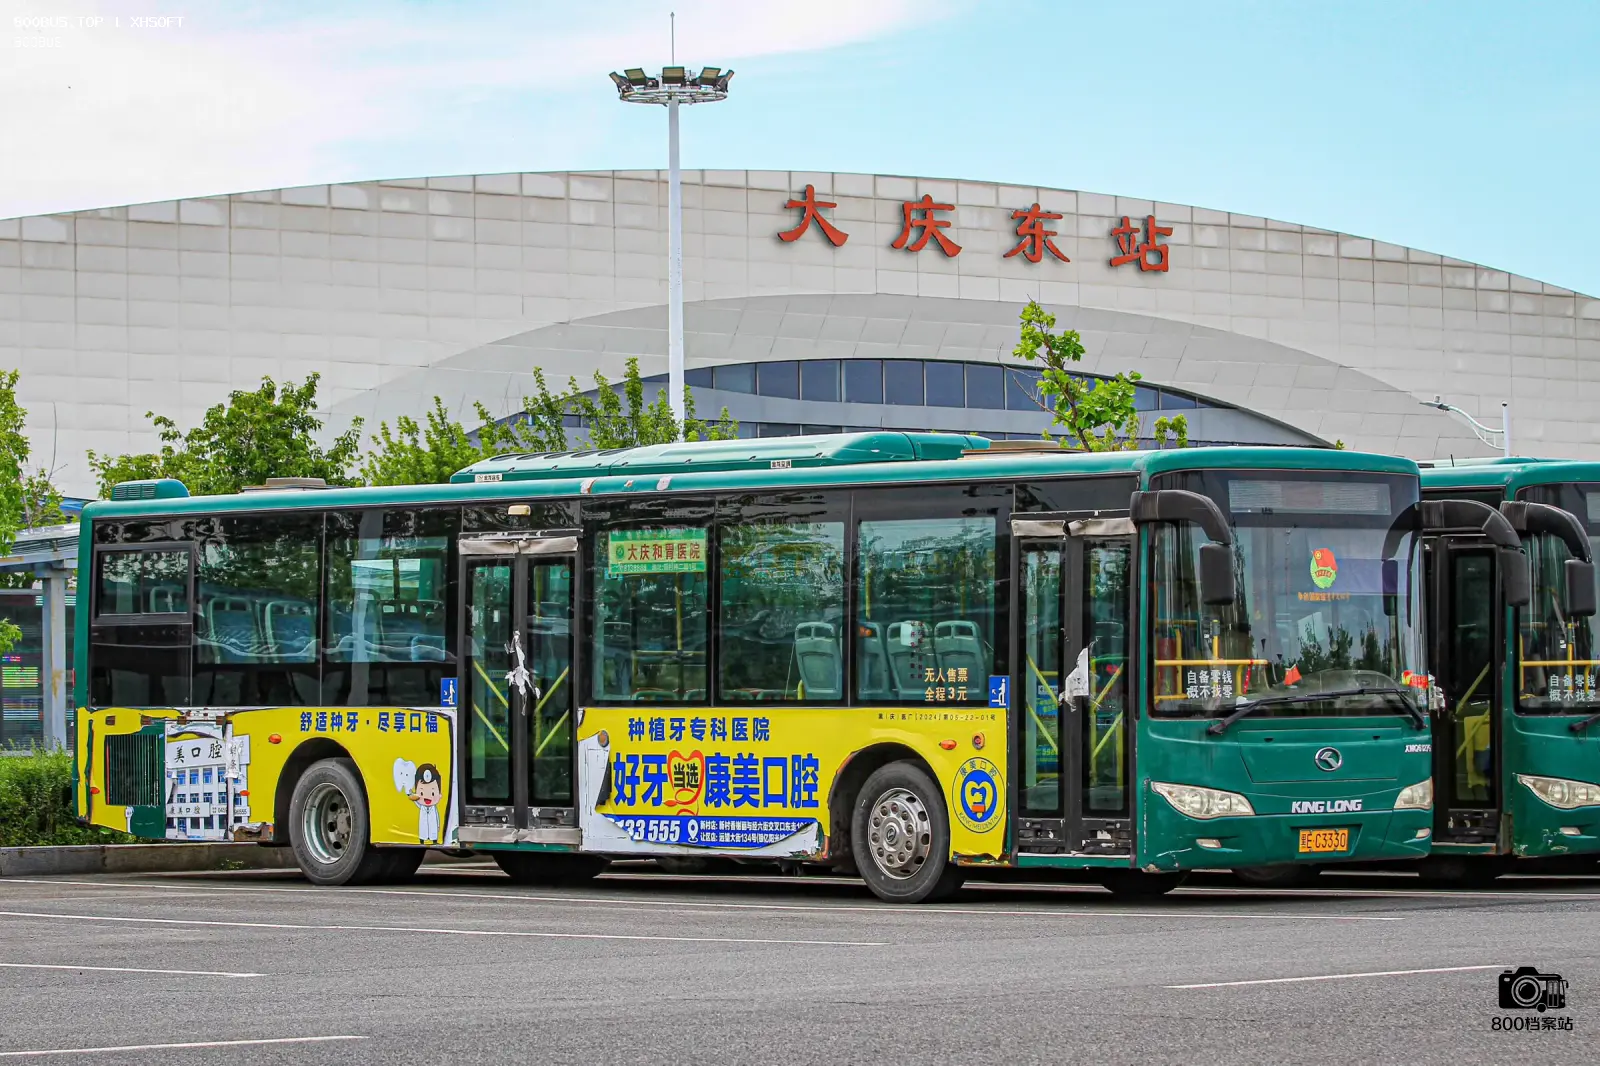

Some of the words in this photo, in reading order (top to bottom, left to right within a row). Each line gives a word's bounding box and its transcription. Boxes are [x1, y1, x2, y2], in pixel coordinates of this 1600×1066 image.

[777, 183, 1174, 273] 大庆东站
[628, 543, 700, 560] 大庆和胃医院
[924, 668, 968, 682] 无人售票
[1187, 670, 1233, 684] 自备零钱
[1550, 674, 1595, 687] 自备零钱
[924, 686, 968, 702] 全程3元
[1186, 685, 1233, 699] 概不找零
[1549, 689, 1595, 702] 概不找零
[628, 717, 770, 742] 种植牙专科医院
[613, 752, 669, 807] 好牙
[673, 762, 699, 789] 当选
[704, 752, 819, 808] 康美口腔
[1291, 801, 1325, 813] KING
[1327, 800, 1363, 812] LONG
